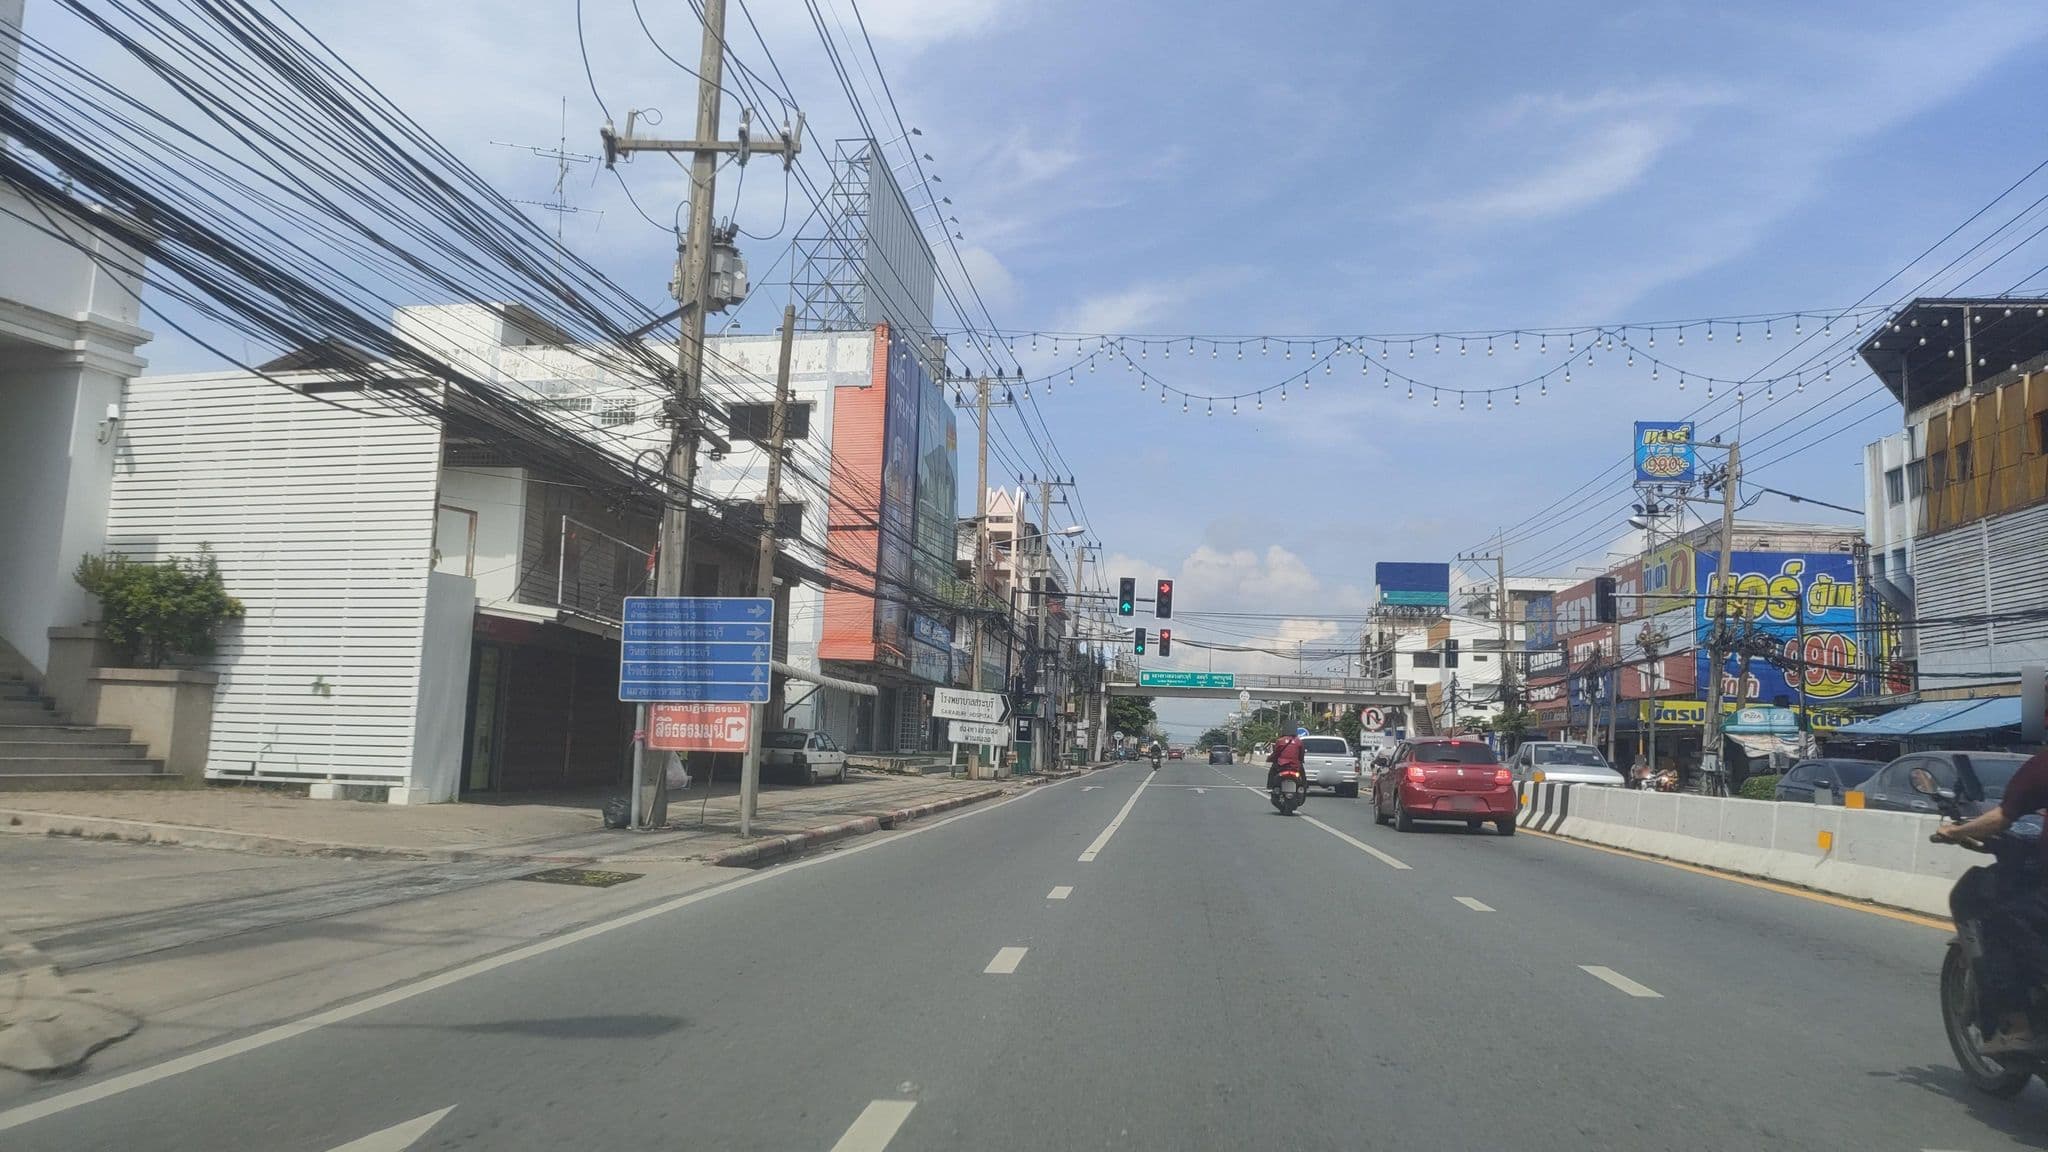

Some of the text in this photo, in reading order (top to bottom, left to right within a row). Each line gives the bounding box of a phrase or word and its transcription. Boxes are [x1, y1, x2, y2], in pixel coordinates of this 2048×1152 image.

[940, 691, 995, 711] โรงพยาบาลสระบุรี
